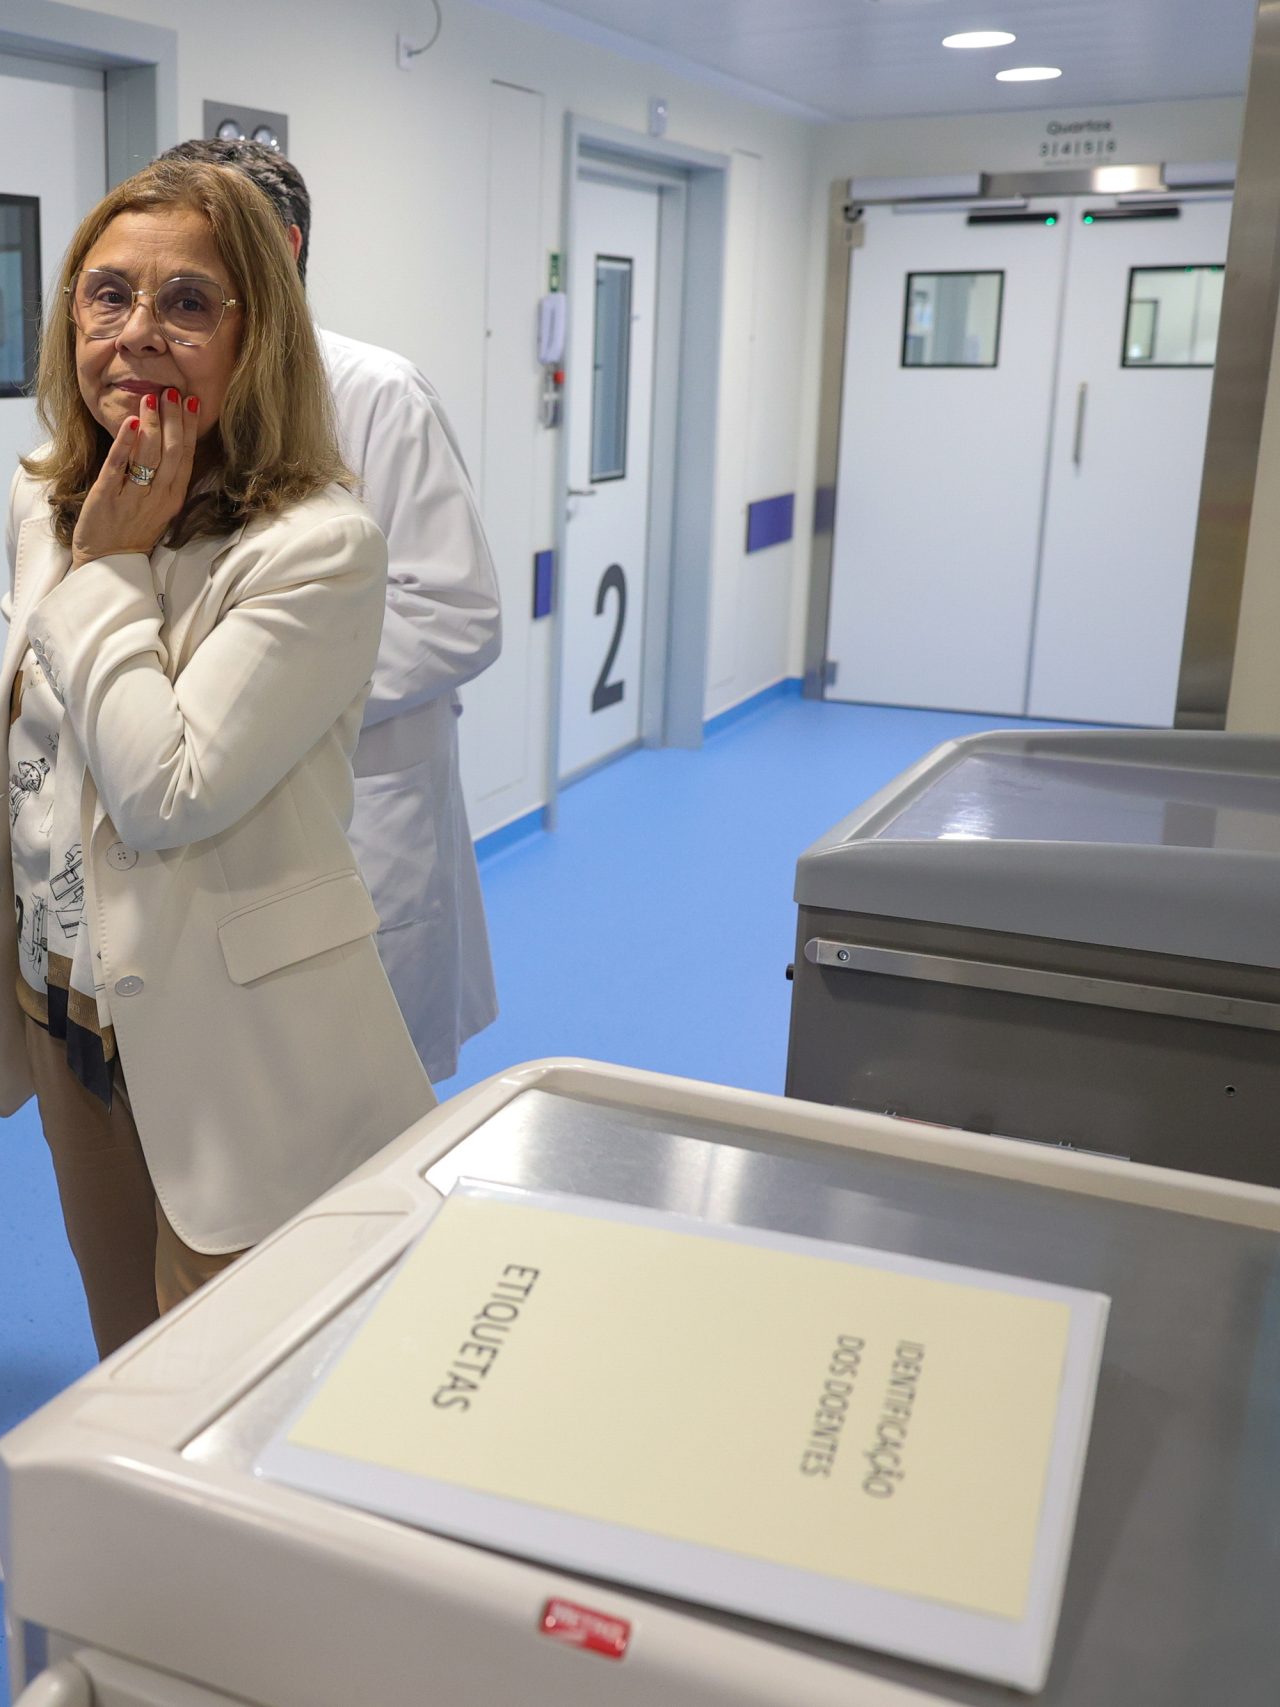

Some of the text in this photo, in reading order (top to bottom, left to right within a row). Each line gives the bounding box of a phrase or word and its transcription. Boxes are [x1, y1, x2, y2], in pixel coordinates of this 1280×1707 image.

[590, 562, 628, 714] 2
[431, 1263, 541, 1414] ETIQUETAS
[799, 1333, 866, 1480] DOS DOENTES
[861, 1339, 927, 1500] IDENTIFICAÇÃO
